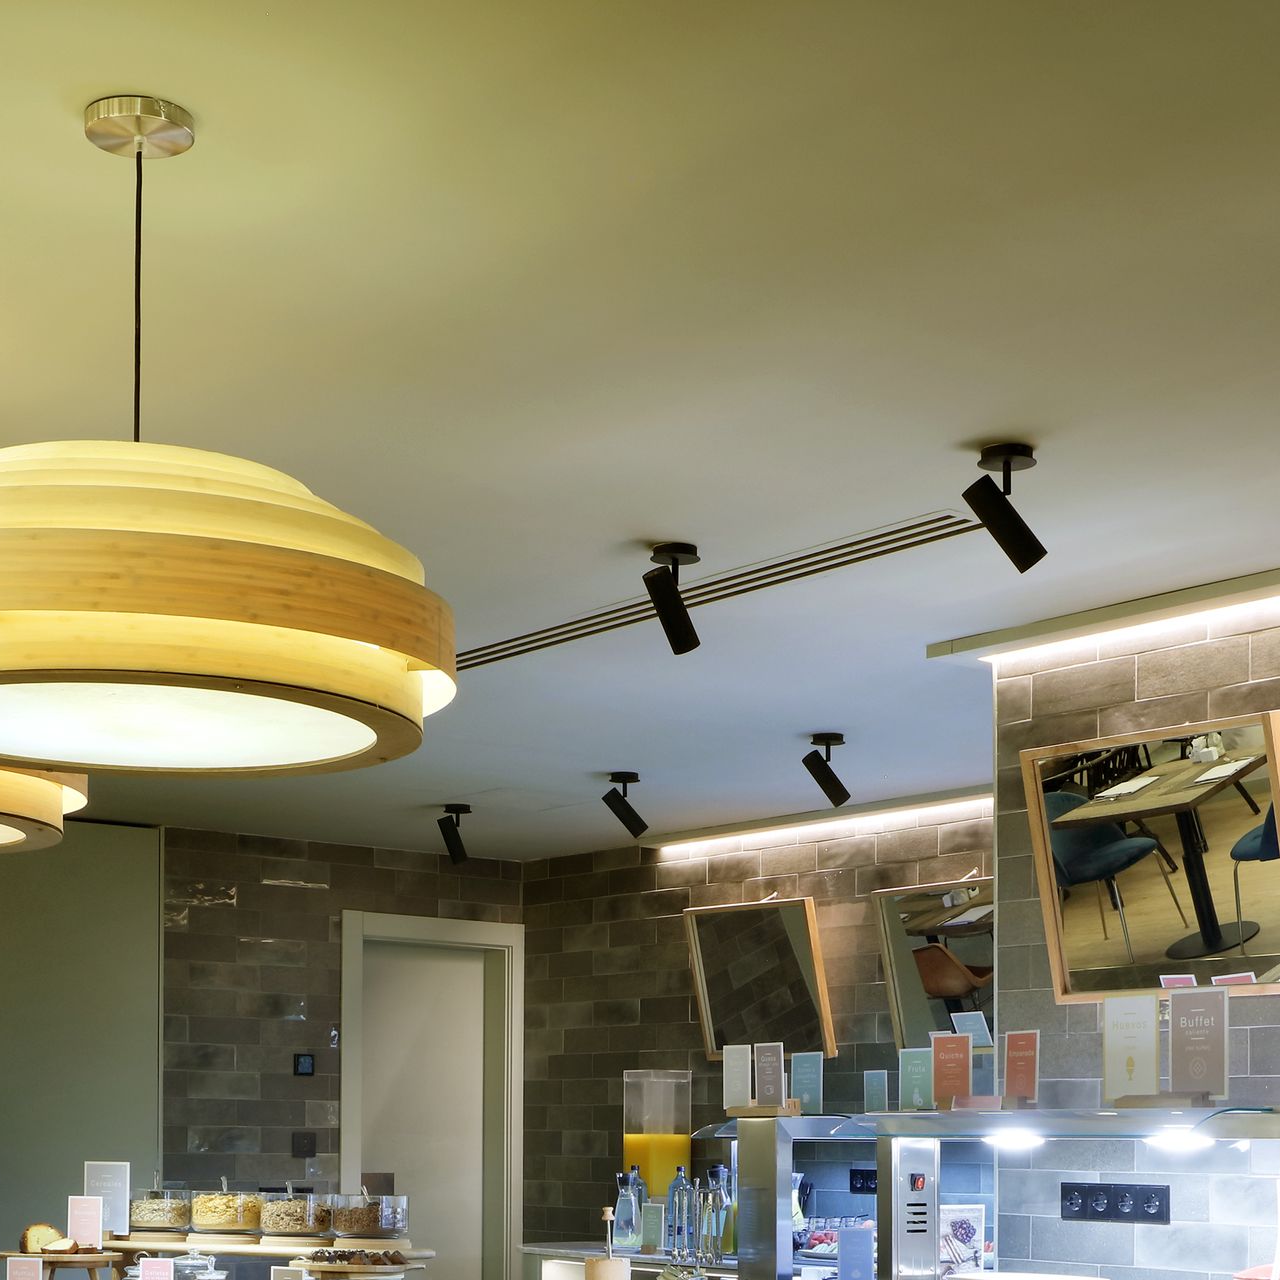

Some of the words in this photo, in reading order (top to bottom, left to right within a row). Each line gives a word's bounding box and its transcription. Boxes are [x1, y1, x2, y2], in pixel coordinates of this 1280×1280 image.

[1112, 1020, 1147, 1031] Huevos
[1180, 1015, 1215, 1028] Buffet
[907, 1065, 926, 1073] Fruta
